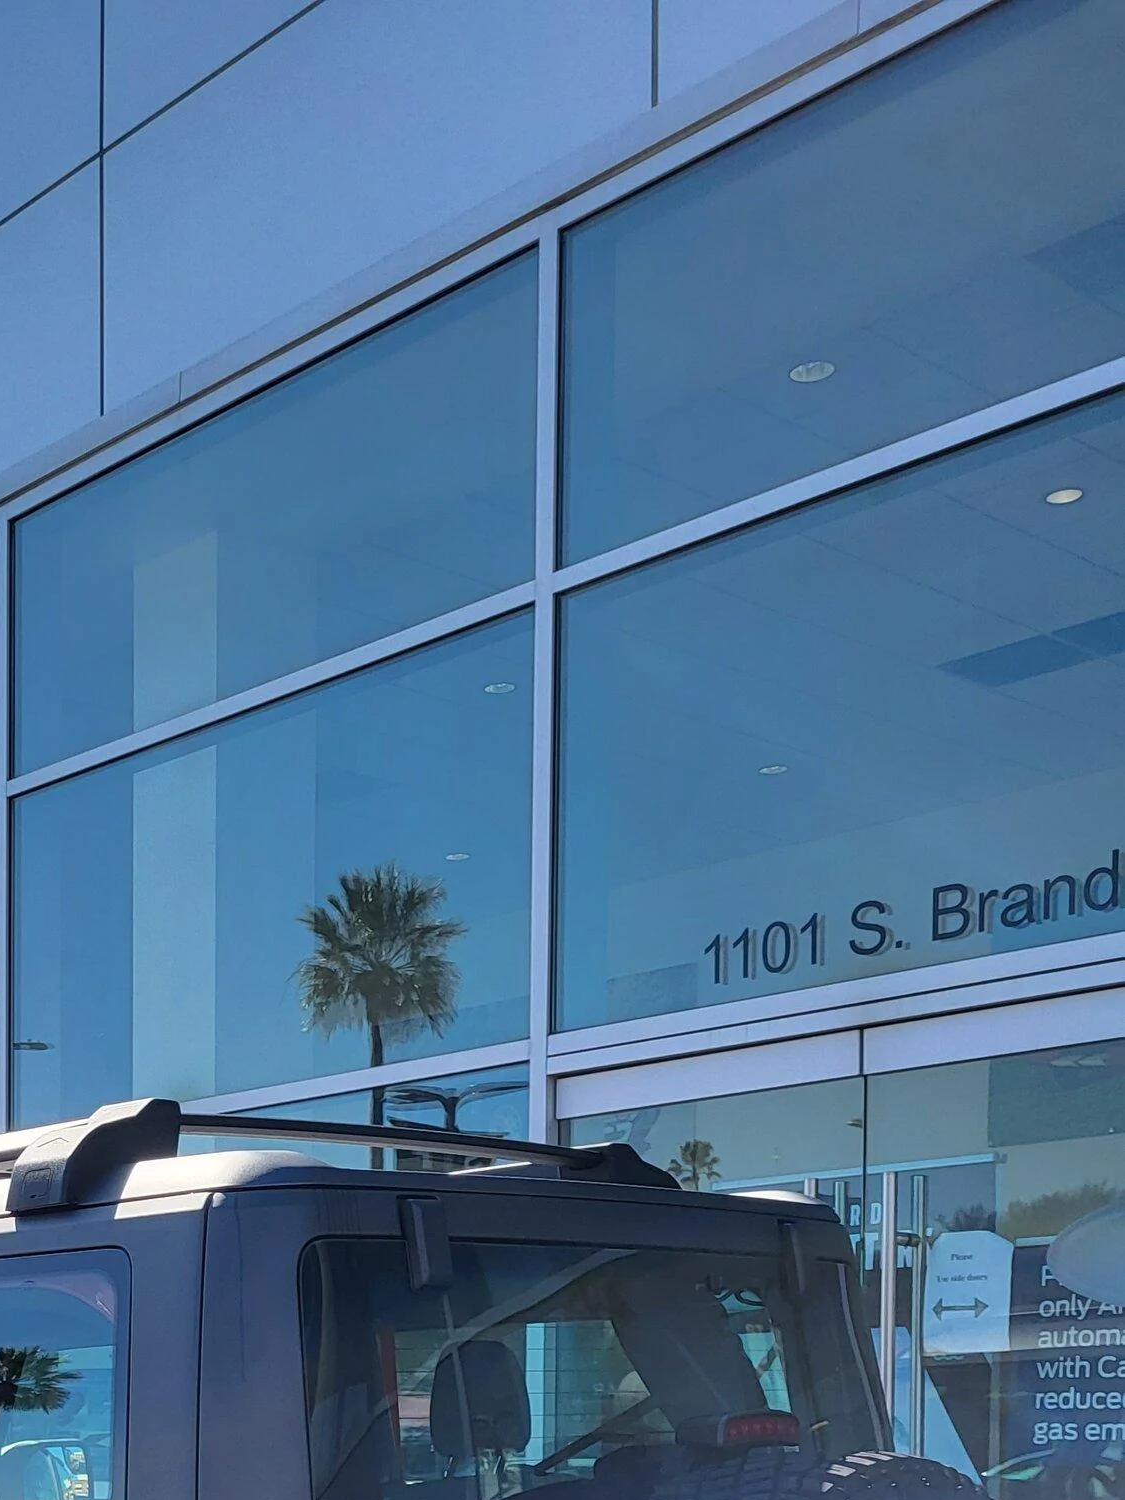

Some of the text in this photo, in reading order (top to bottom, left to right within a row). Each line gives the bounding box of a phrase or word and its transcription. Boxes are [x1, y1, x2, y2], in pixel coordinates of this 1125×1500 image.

[703, 848, 1120, 985] 1101 S. Brand
[1039, 1293, 1092, 1320] only
[1036, 1355, 1091, 1379] with
[1033, 1422, 1078, 1445] gas
